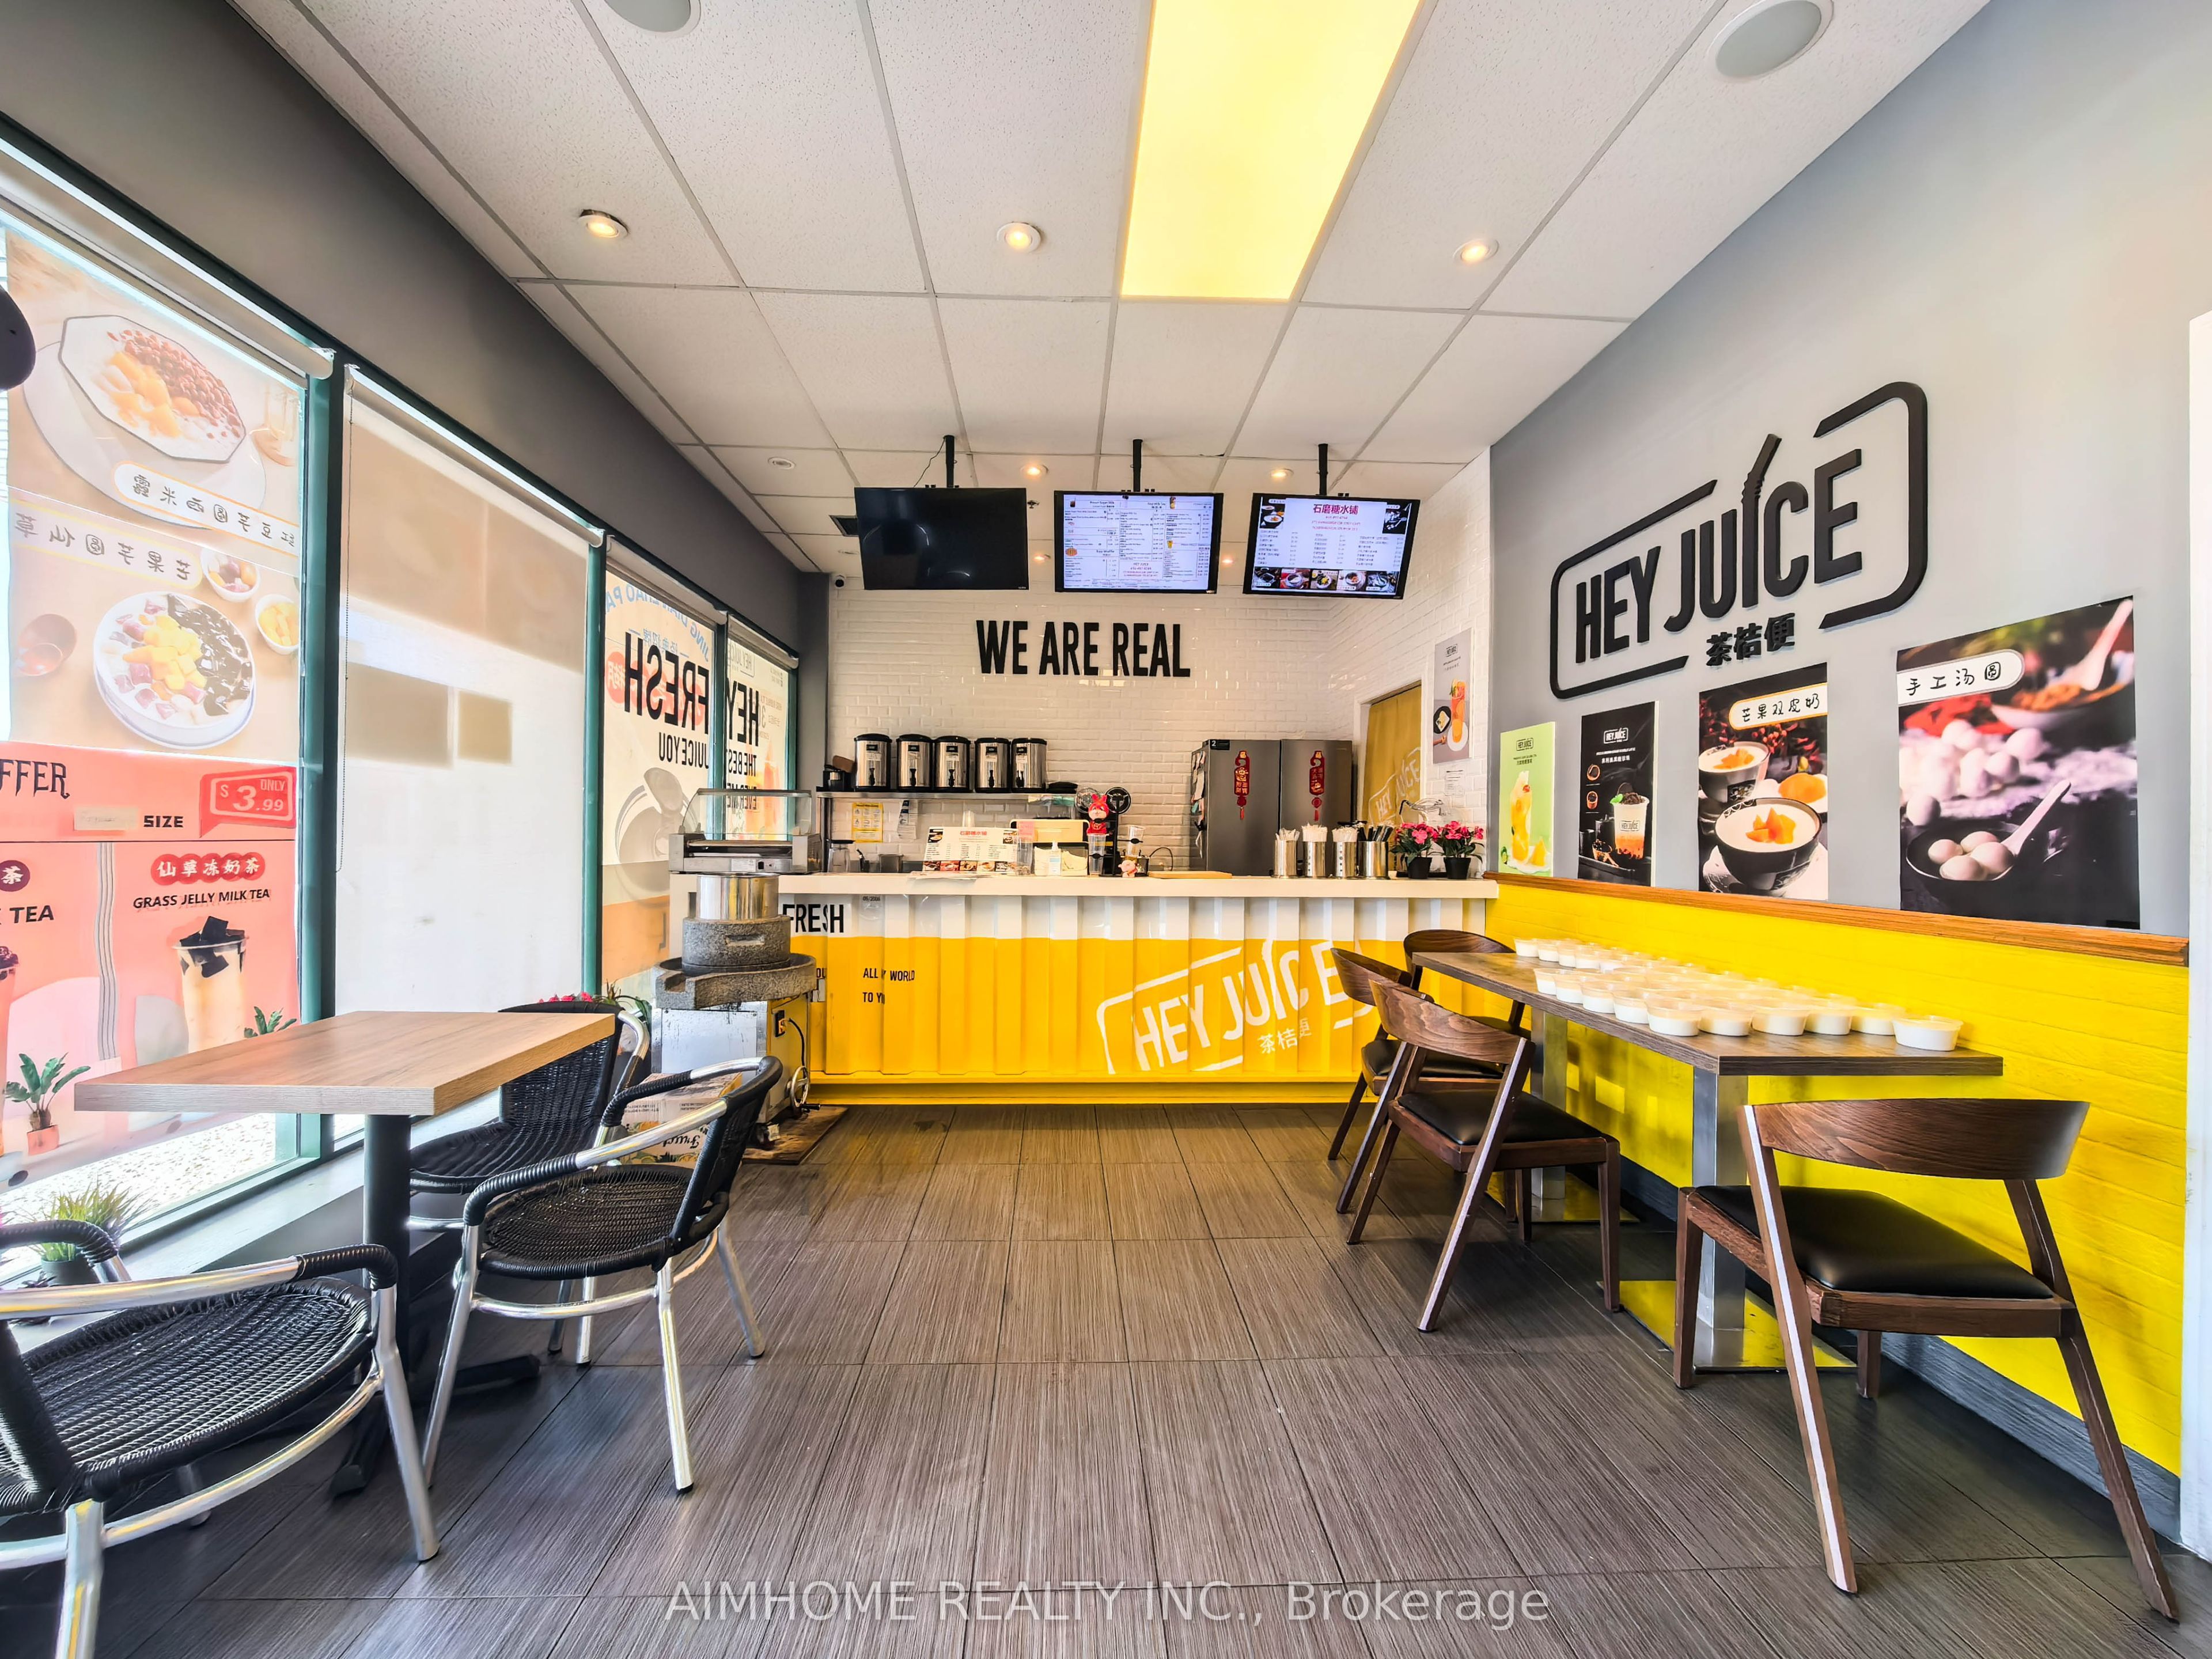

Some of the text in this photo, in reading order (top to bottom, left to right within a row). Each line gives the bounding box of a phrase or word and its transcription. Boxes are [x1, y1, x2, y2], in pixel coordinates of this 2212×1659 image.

[1576, 434, 1862, 663] HEY JUICE
[976, 620, 1191, 677] WE ARE REAL
[1906, 661, 2002, 696] 手工汤圆
[1741, 692, 1820, 722] 芒果双皮奶
[260, 778, 286, 793] ONLY
[143, 815, 184, 829] SIZE
[1, 866, 24, 885] 茶
[157, 857, 260, 878] 仙草冻奶茶
[133, 889, 270, 909] GRASS JELLY MILK TEA
[9, 905, 54, 923] TEA
[782, 904, 844, 933] FRESH
[863, 968, 878, 979] ALL
[890, 970, 915, 982] WORLD
[862, 992, 873, 1003] TO
[1133, 938, 1349, 1071] HEY JUICE
